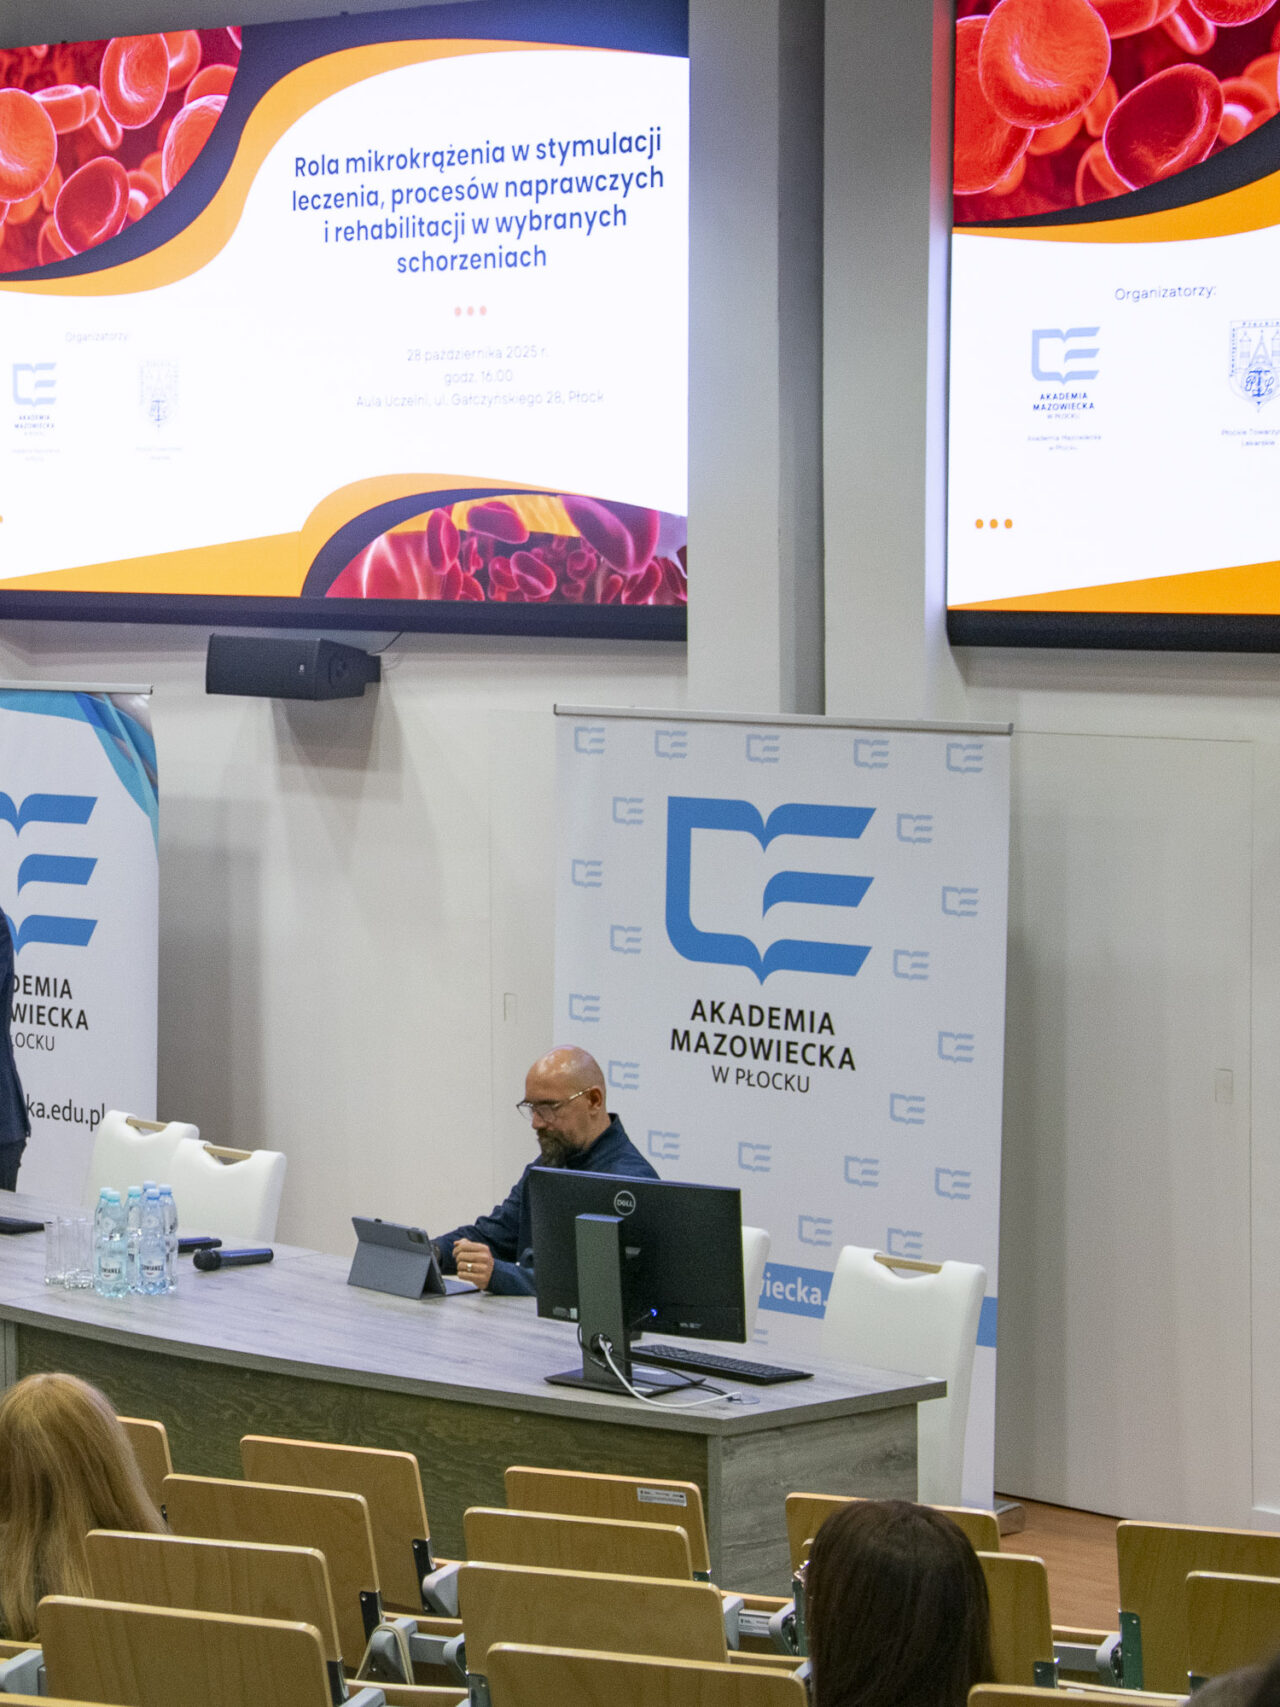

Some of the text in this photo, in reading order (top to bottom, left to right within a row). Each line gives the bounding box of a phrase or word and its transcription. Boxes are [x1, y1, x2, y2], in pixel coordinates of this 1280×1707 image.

[295, 126, 663, 178] Rola mikrokrążenia w stymulacji
[292, 165, 665, 213] leczenia, procesów naprawczych
[324, 204, 628, 244] i rehabilitacji w wybranych
[397, 245, 548, 274] schorzeniach
[1114, 285, 1217, 303] Organizatorzy:
[407, 348, 422, 363] 28
[506, 345, 538, 360] 2025
[1032, 402, 1095, 411] MAZOWIECKA
[1040, 392, 1088, 401] AKADEMIA
[690, 998, 836, 1036] AKADEMIA
[12, 1031, 55, 1052] OCKU
[670, 1028, 856, 1072] MAZOWIECKA
[711, 1065, 810, 1094] W PŁOCKU
[616, 1199, 633, 1208] DELL
[760, 1271, 829, 1307] iecka.
